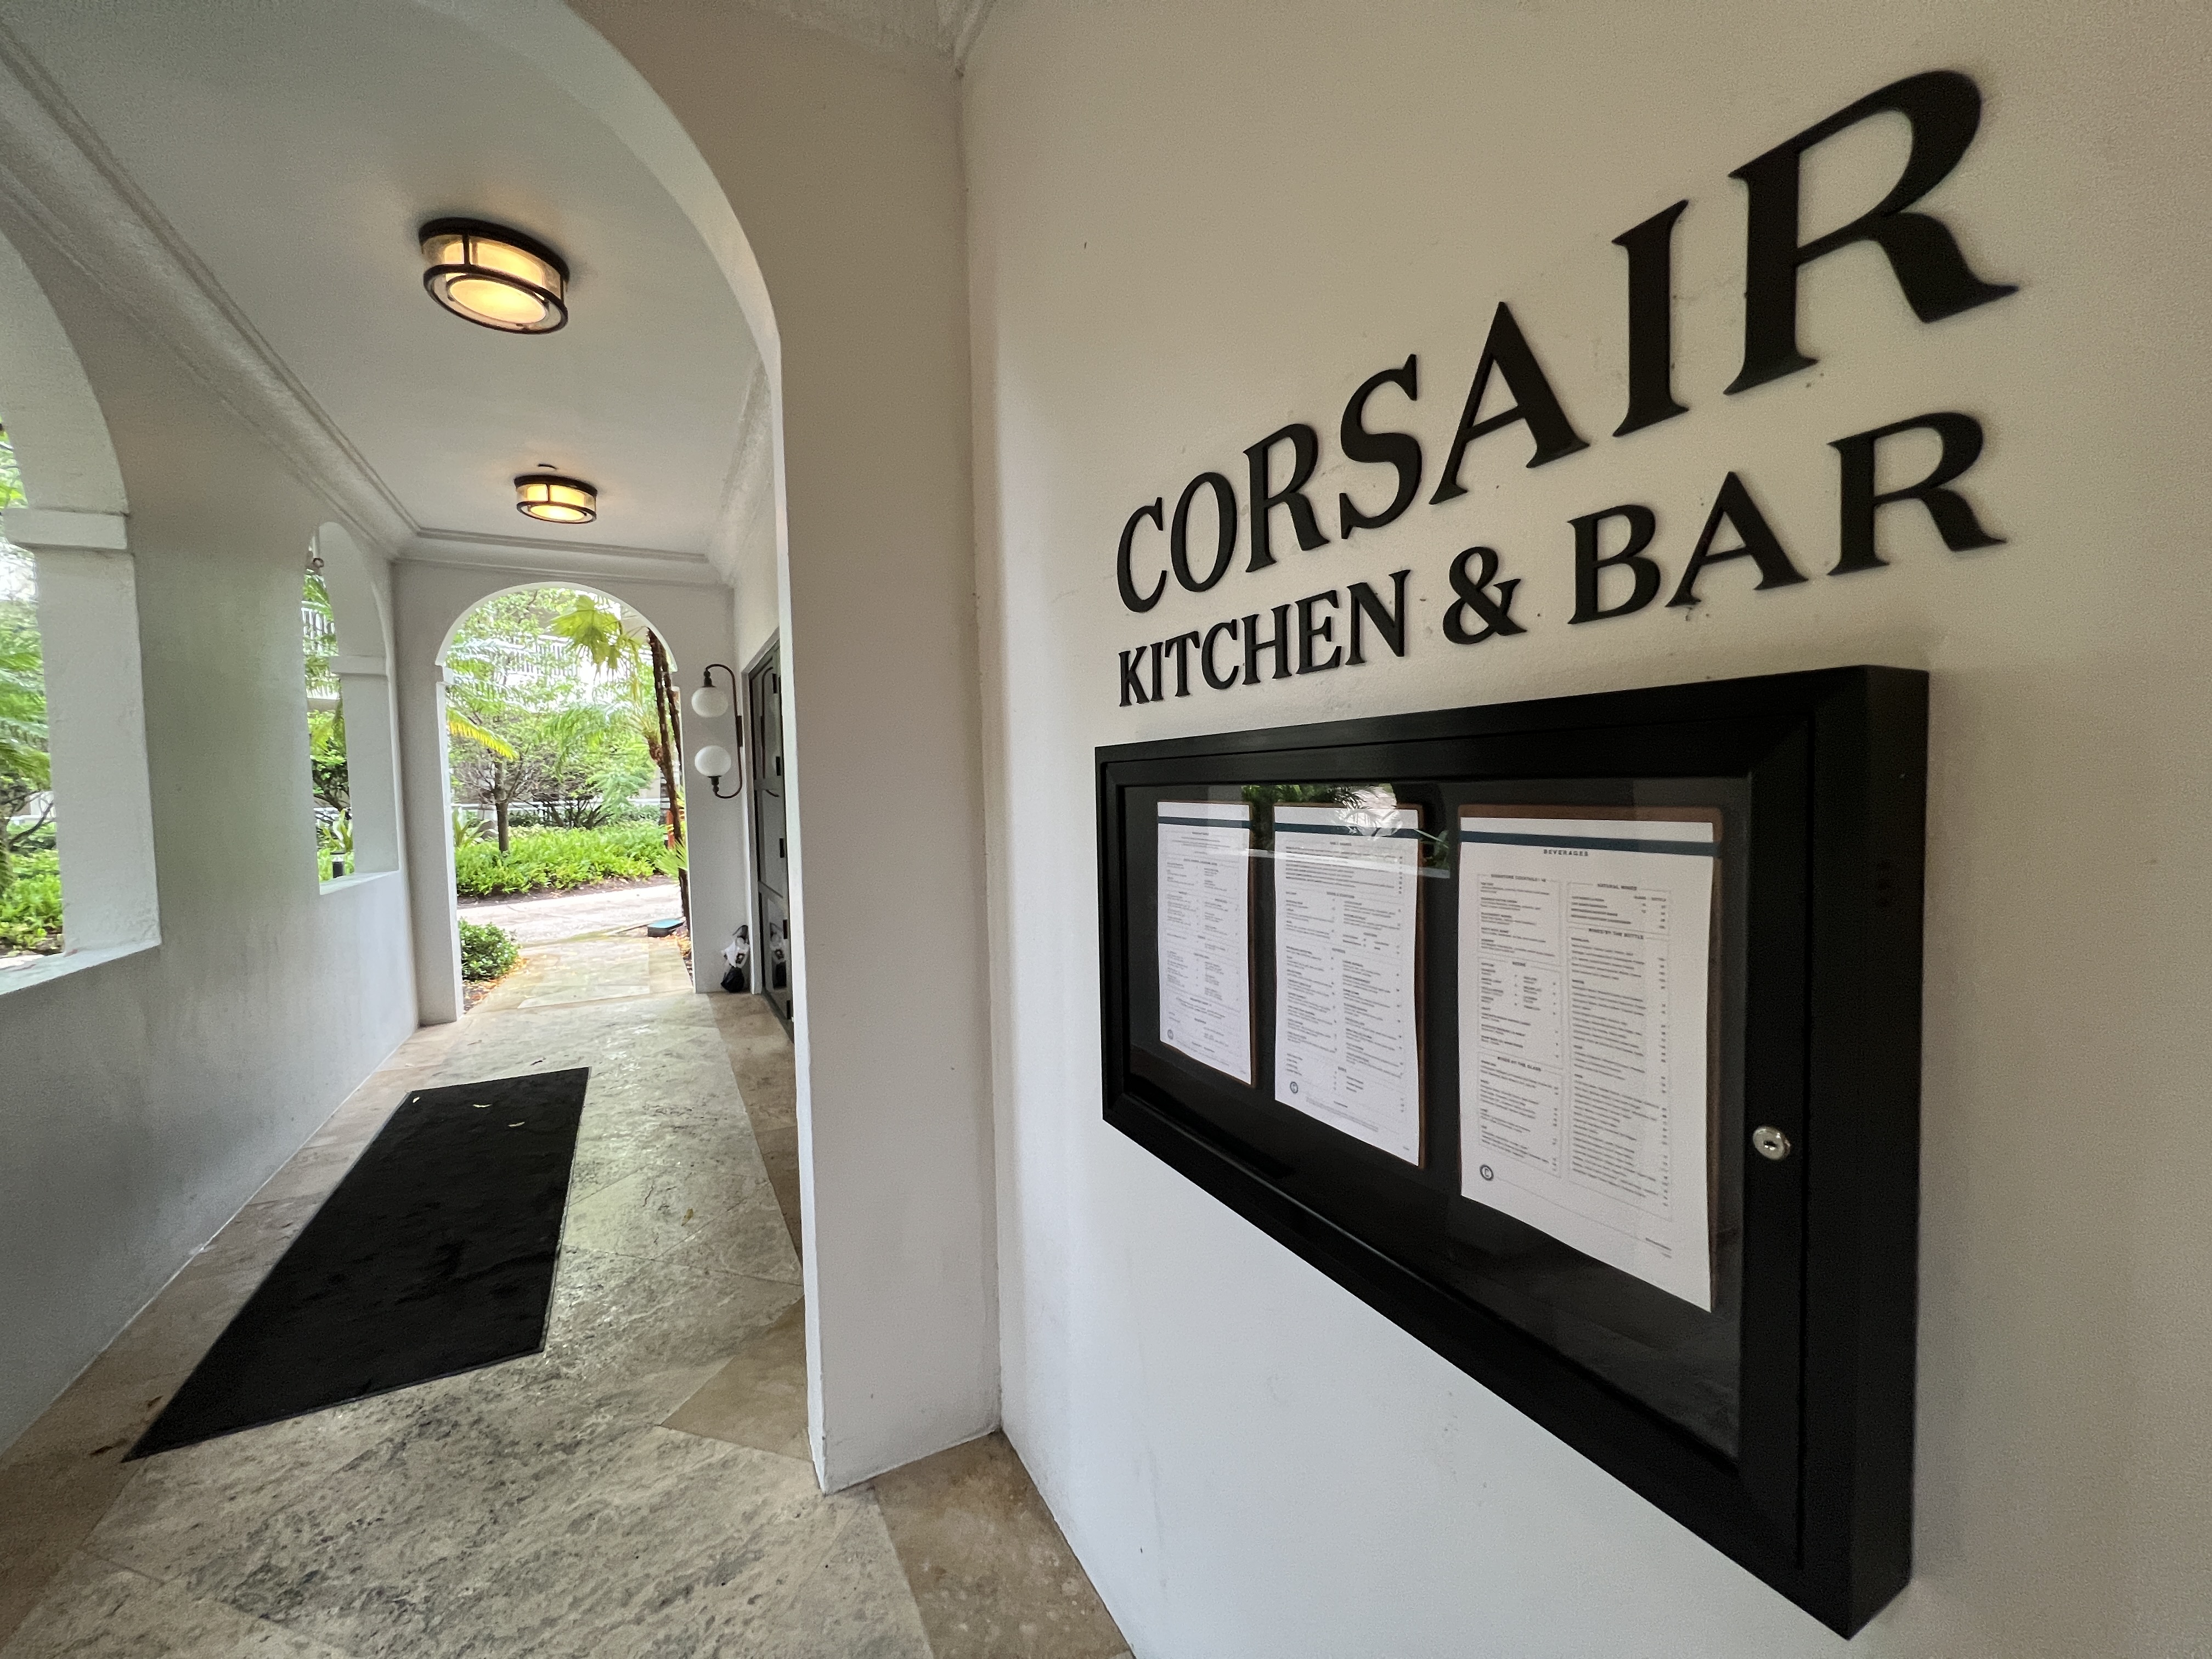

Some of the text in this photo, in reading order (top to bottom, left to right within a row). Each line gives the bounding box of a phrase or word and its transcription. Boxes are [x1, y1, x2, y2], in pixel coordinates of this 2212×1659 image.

[1116, 69, 2019, 613] CORSAIR
[1118, 411, 2007, 707] KITCHEN & BAR
